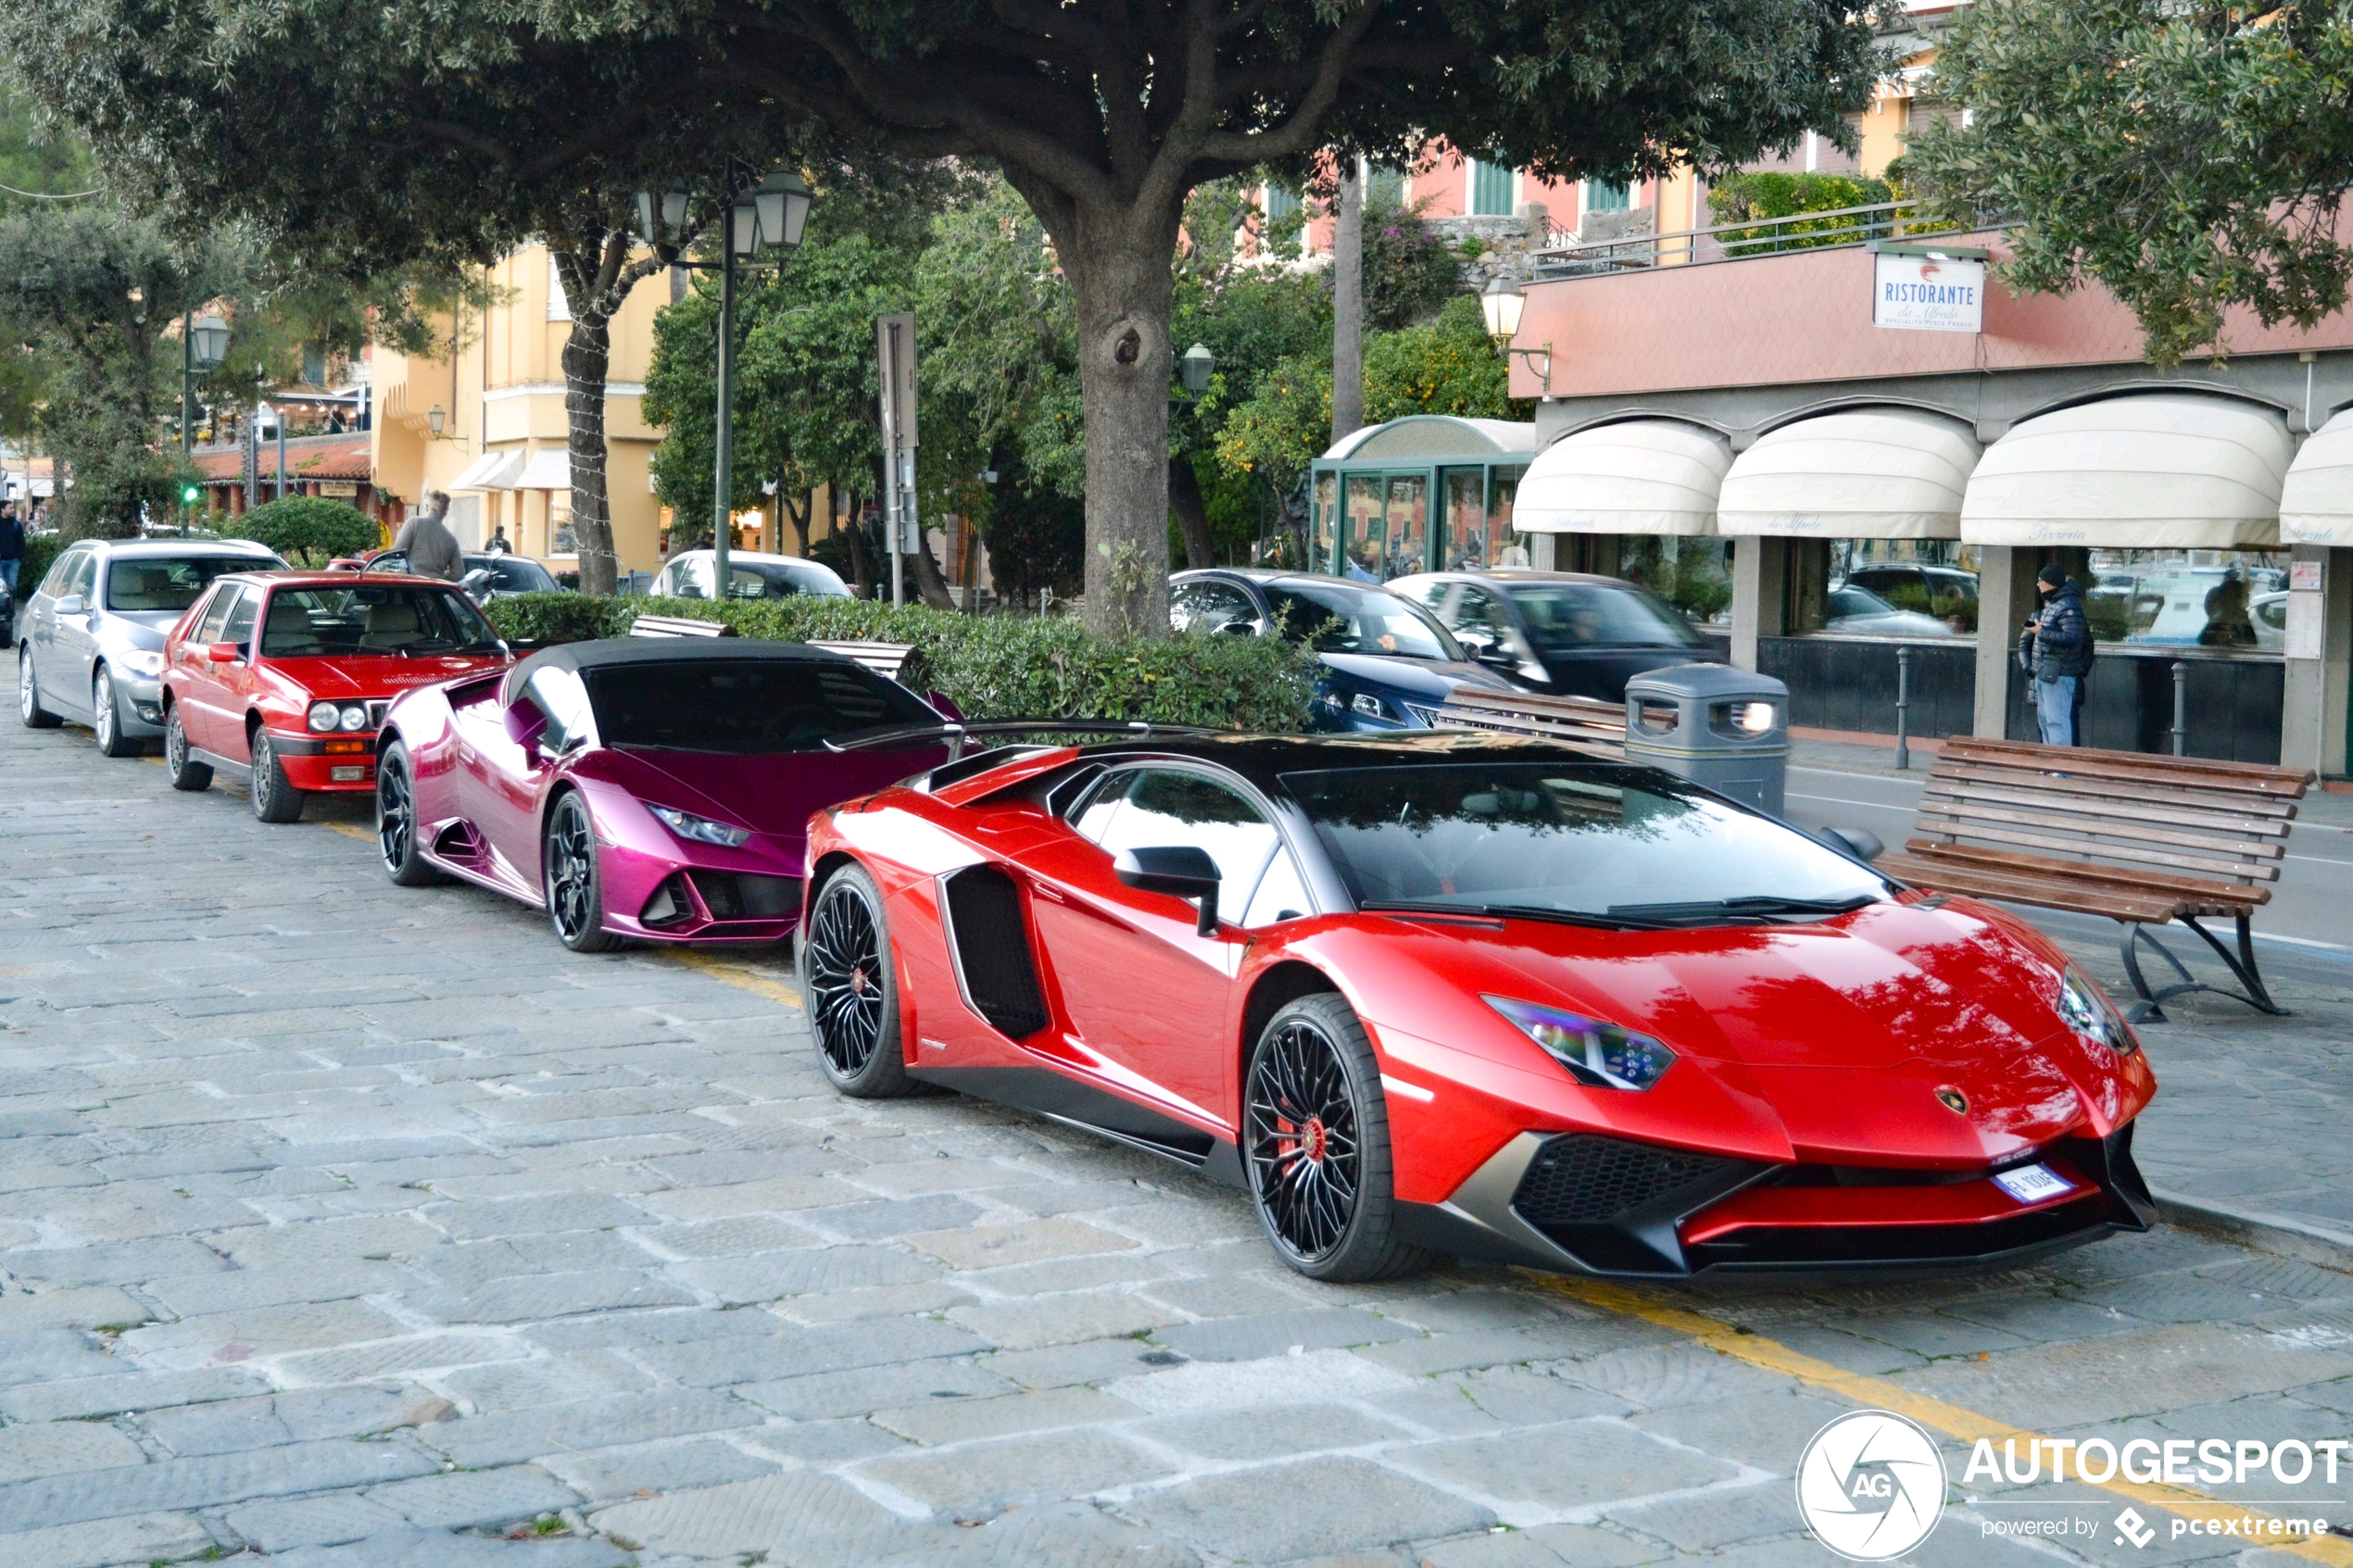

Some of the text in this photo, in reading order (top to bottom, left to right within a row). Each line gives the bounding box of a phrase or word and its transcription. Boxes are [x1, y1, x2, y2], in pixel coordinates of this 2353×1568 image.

[1885, 282, 1974, 306] RISTORANTE
[1897, 304, 1958, 320] da Alfredo
[1550, 516, 1595, 529] Ristorante
[1782, 512, 1821, 533] Alfredo
[2028, 520, 2086, 540] Pizzeria
